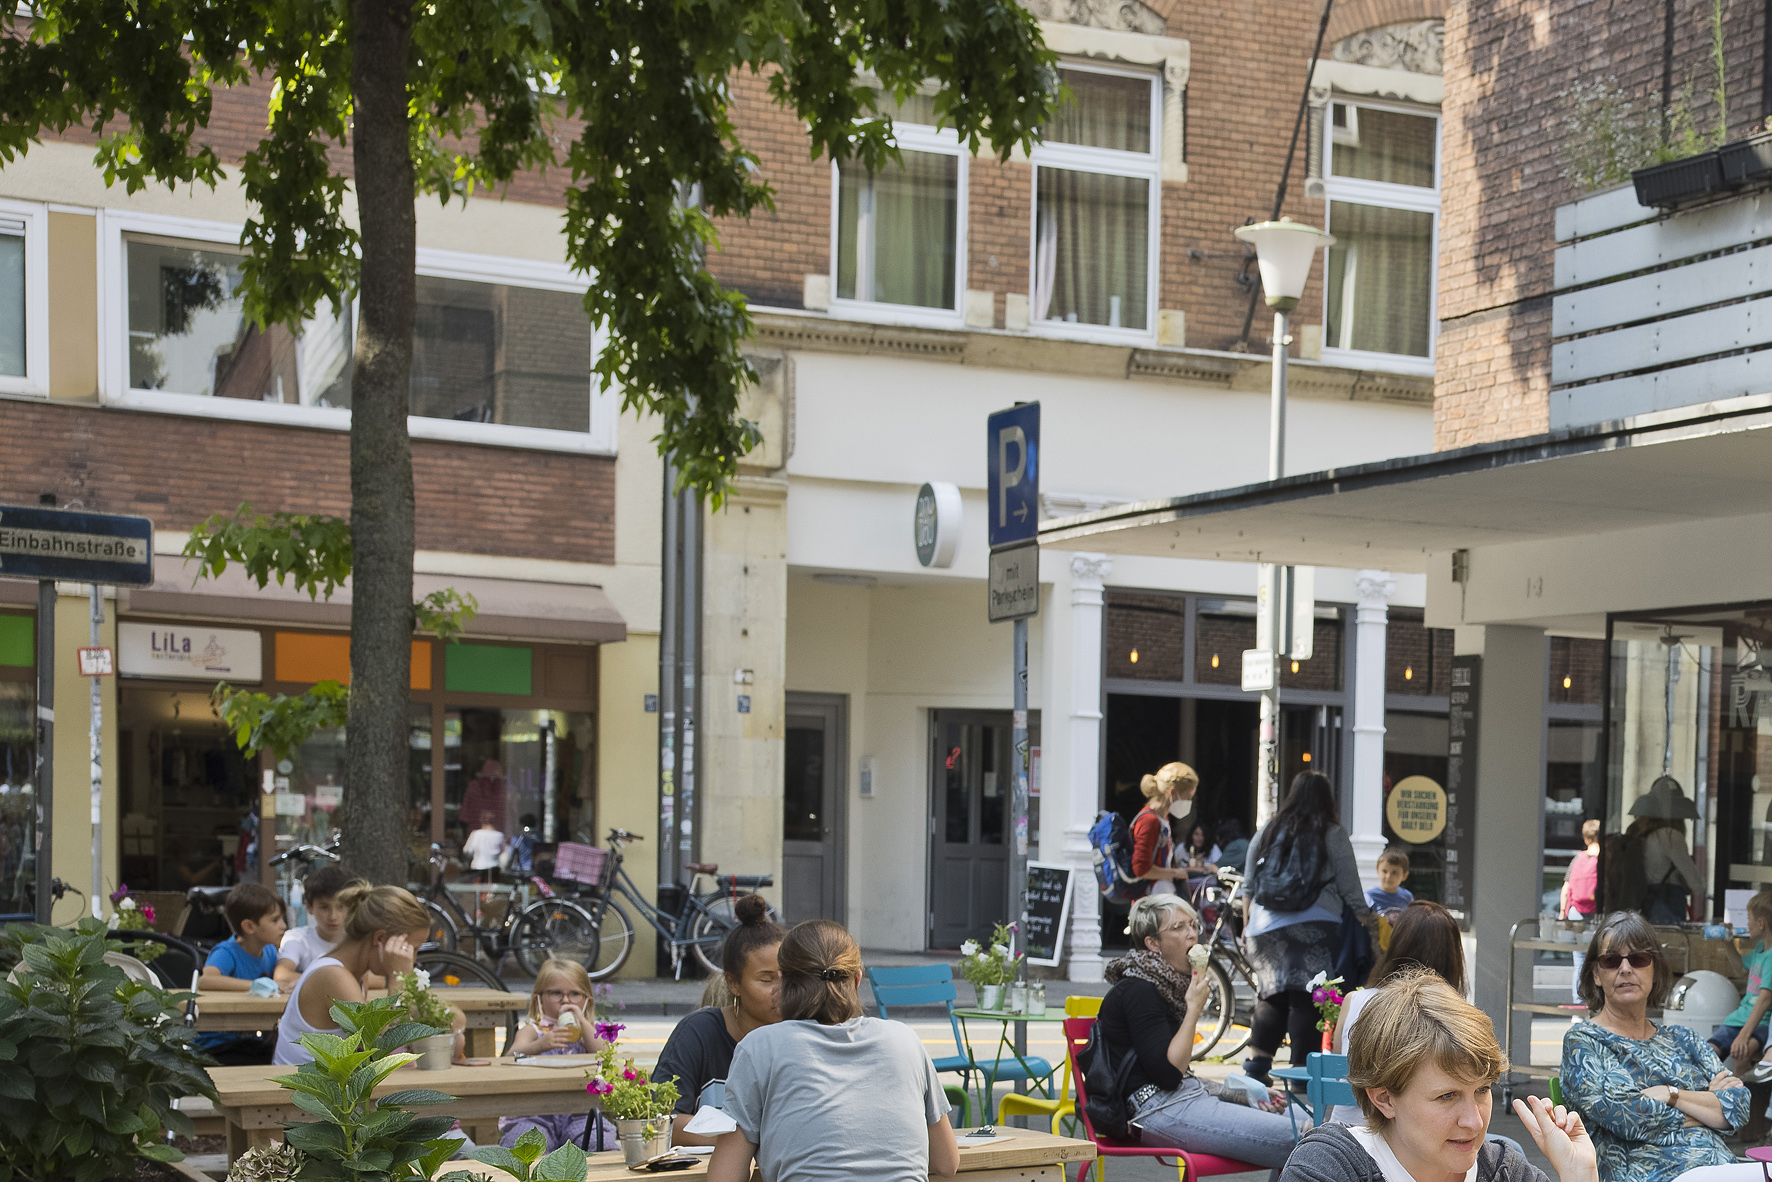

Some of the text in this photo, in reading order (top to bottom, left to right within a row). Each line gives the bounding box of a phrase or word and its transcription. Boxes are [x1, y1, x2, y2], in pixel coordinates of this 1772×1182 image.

[1000, 425, 1027, 528] P
[0, 531, 136, 558] Einbahnstraße
[1005, 562, 1019, 581] mit
[151, 630, 192, 653] LiLa
